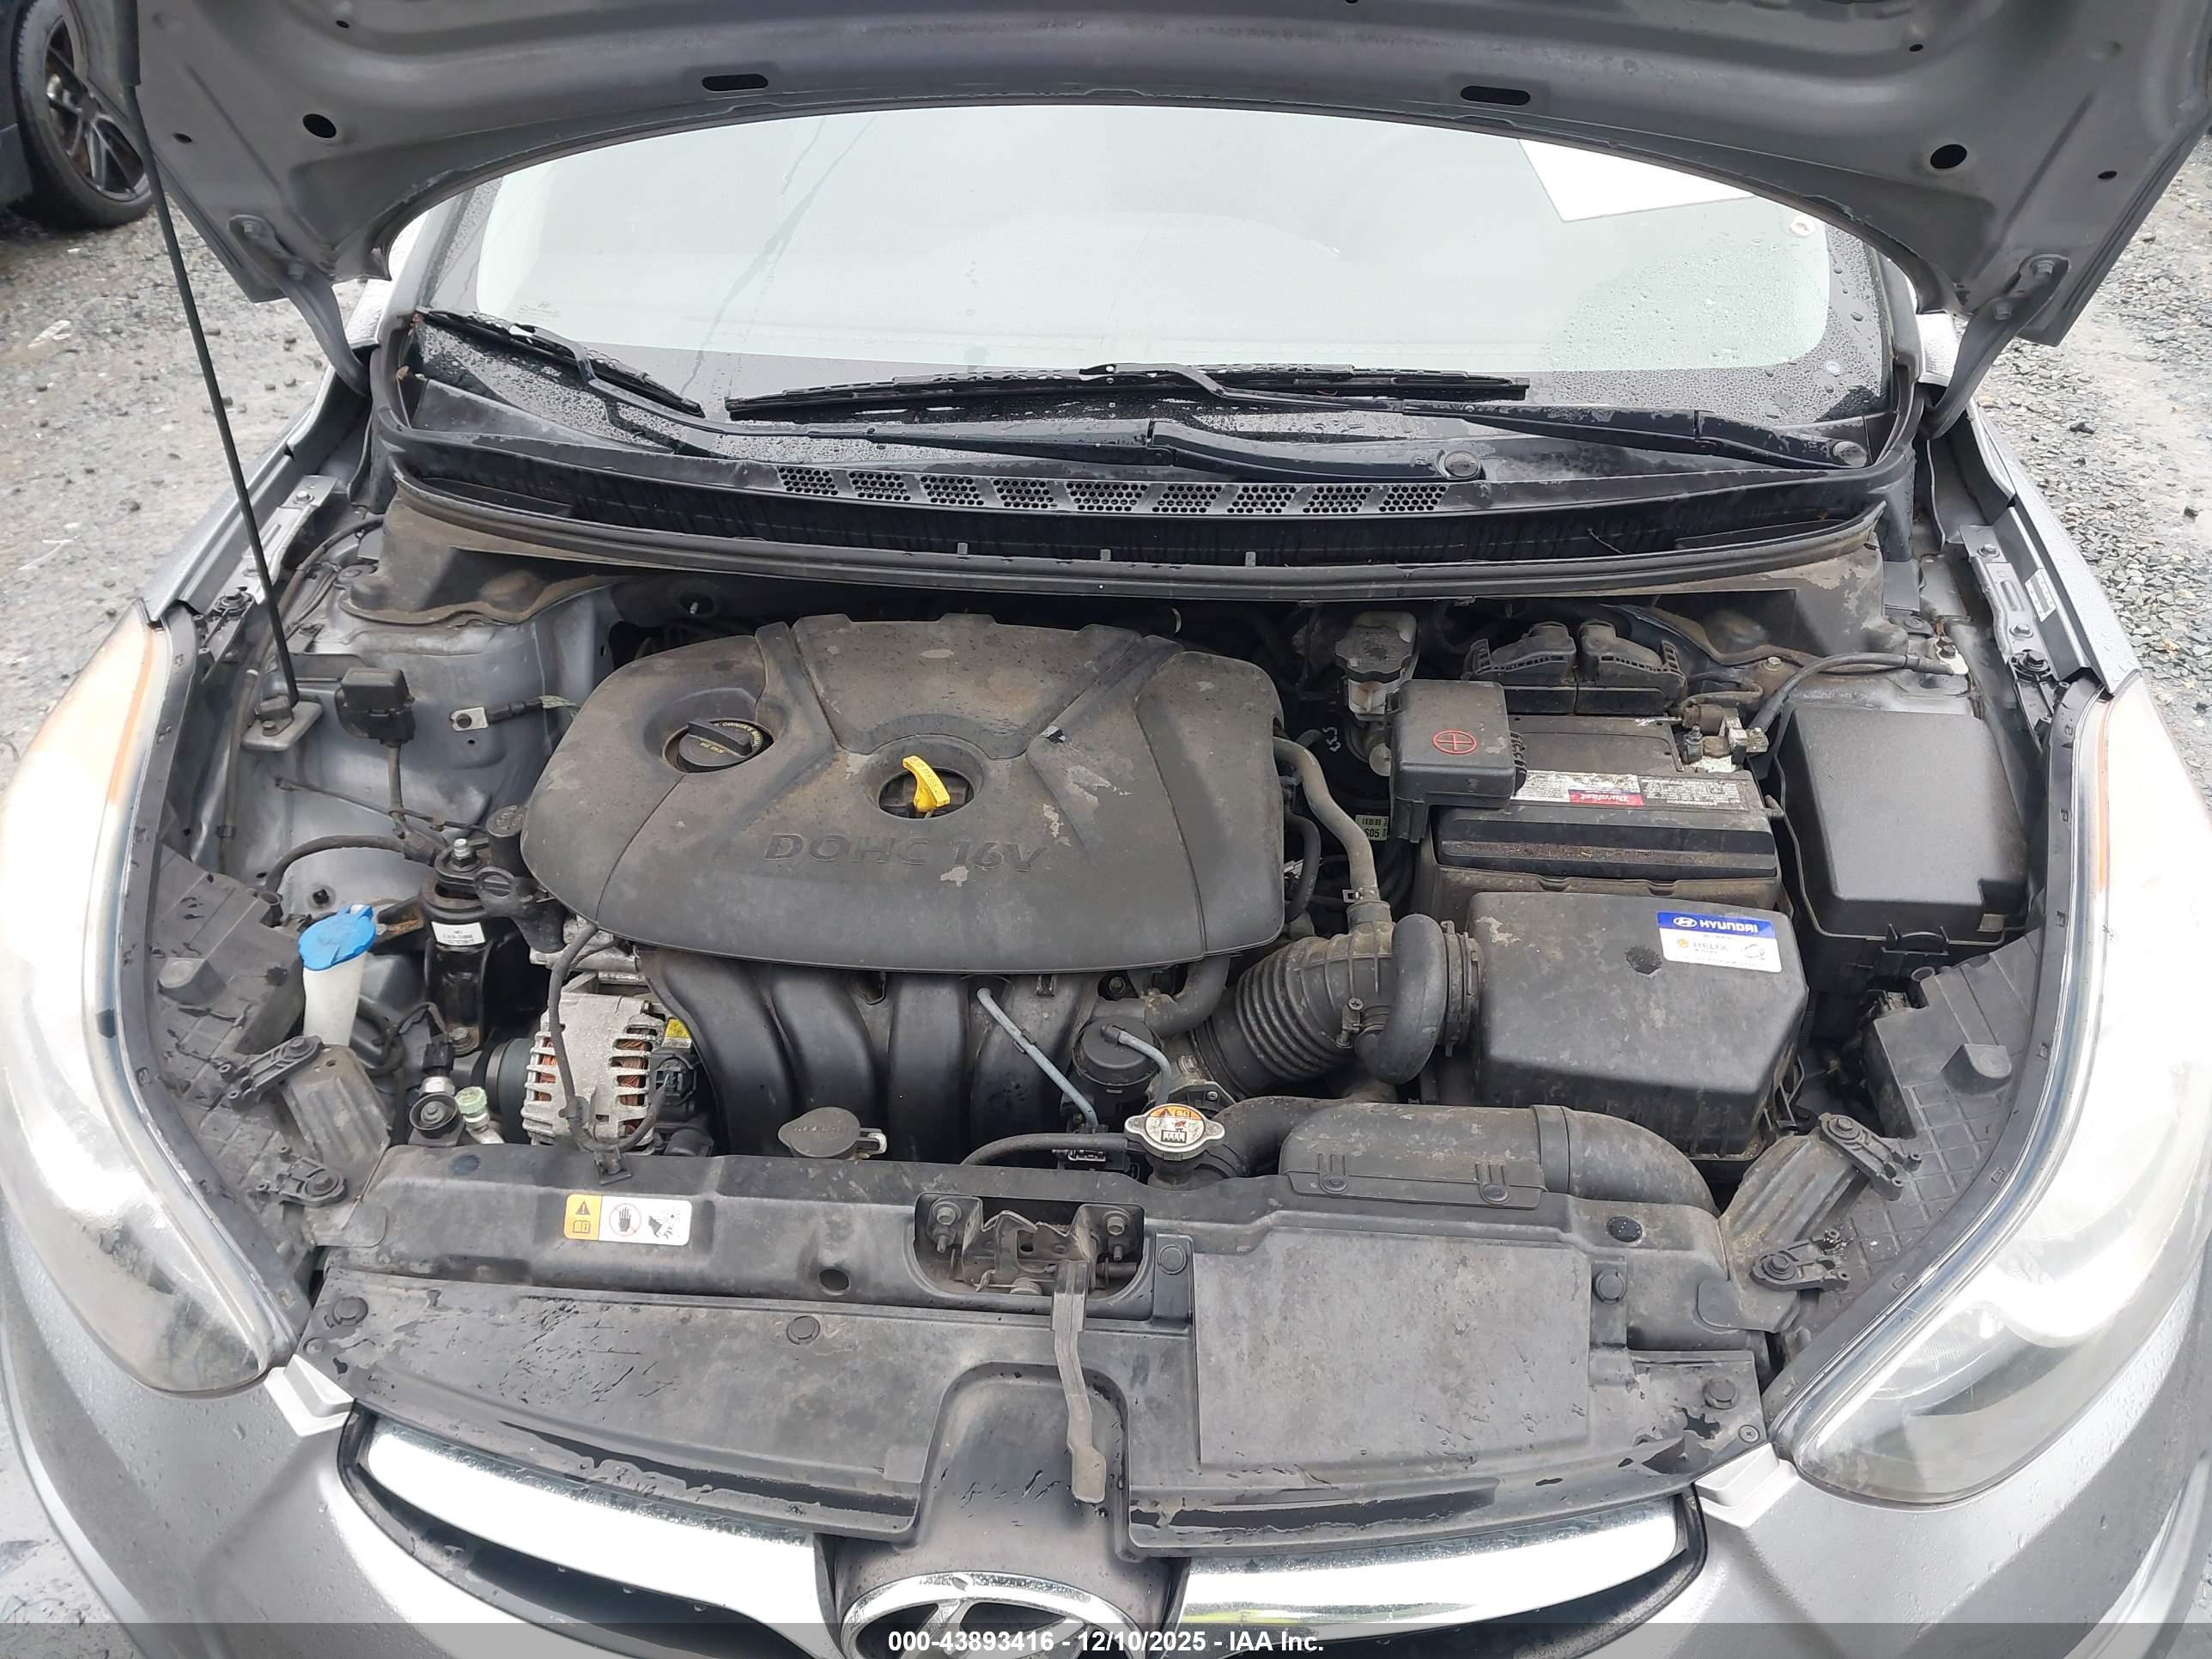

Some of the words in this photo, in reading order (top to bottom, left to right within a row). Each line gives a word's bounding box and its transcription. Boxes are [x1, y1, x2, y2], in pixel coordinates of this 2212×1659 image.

[763, 834, 932, 866] DOHC
[949, 838, 1049, 872] 16V
[1699, 919, 1759, 933] HYUNDAI
